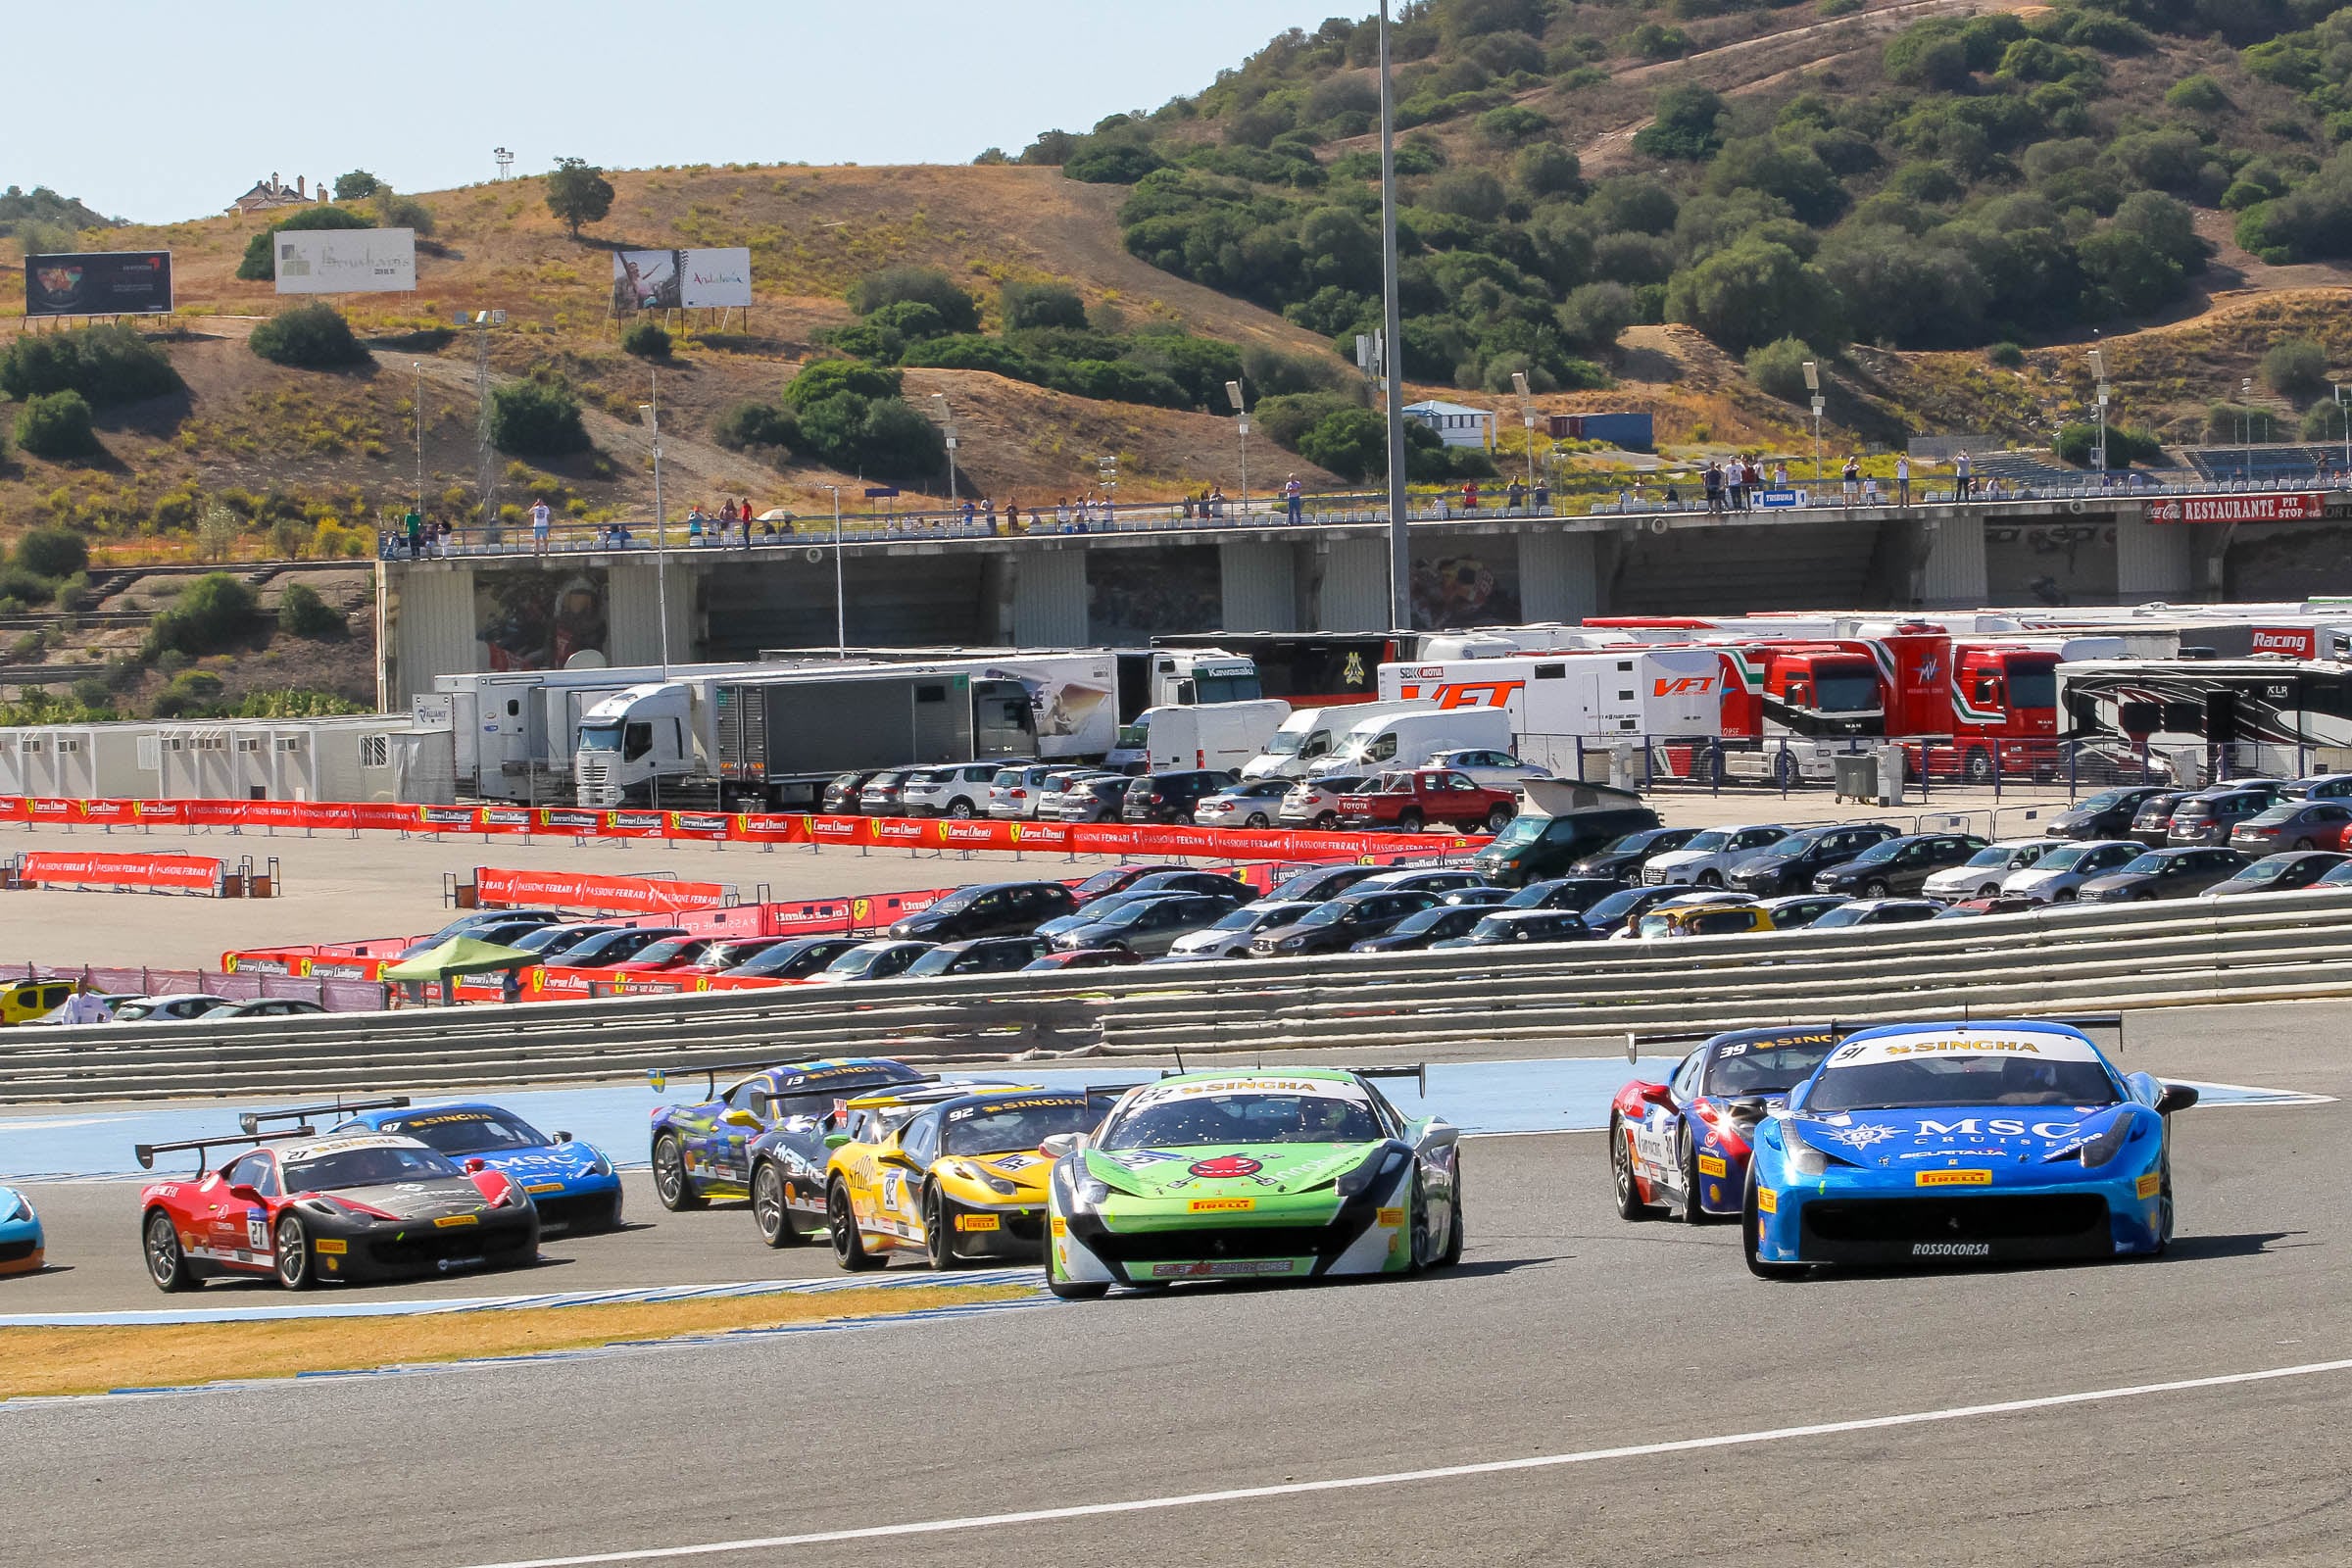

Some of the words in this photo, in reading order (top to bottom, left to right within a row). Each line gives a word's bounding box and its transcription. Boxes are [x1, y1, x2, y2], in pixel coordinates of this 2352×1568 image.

[2282, 497, 2299, 507] PIT
[2185, 499, 2275, 520] RESTAURANTE
[2278, 508, 2303, 518] STOP
[2253, 632, 2306, 652] Racing
[1207, 667, 1254, 677] Kawasaki
[1399, 667, 1417, 679] SBK
[1422, 666, 1444, 677] MOTUL
[1653, 677, 1715, 697] VFT
[747, 818, 765, 829] Corse
[765, 819, 787, 830] Clienti
[813, 820, 832, 830] Corse
[832, 820, 854, 831] Clienti
[880, 823, 900, 834] Corse
[900, 823, 922, 834] Clienti
[948, 825, 968, 836] Corse
[968, 825, 992, 837] Clienti
[1020, 827, 1041, 838] Corse
[1041, 827, 1065, 839] Clienti
[1176, 836, 1205, 845] FERRARI
[1218, 838, 1249, 848] PASSIONE
[1250, 840, 1281, 849] FERRARI
[1296, 840, 1327, 850] PASSIONE
[1328, 841, 1359, 851] FERRARI
[1373, 843, 1404, 852] PASSIONE
[122, 864, 146, 873] FERRARI
[183, 867, 206, 876] FERRARI
[517, 883, 544, 892] PASSIONE
[545, 884, 572, 893] FERRARI
[586, 886, 614, 896] PASSIONE
[615, 889, 646, 899] FERRARI
[690, 894, 720, 904] FERRARI
[1719, 1043, 1748, 1059] 39
[1911, 1040, 2040, 1053] SINGHA
[1836, 1046, 1867, 1060] 91
[786, 1076, 805, 1086] 13
[1205, 1081, 1317, 1092] SINGHA
[1001, 1099, 1086, 1109] SINGHA
[949, 1106, 974, 1122] 92
[1915, 1118, 2081, 1139] MSC
[1914, 1135, 2082, 1148] CRUISES
[287, 1151, 308, 1160] 27
[1700, 1159, 1723, 1174] PIRELLI
[1922, 1172, 1985, 1184] PIRELLI
[1193, 1200, 1250, 1210] PIRELLI
[966, 1217, 996, 1228] PIRELLI
[251, 1221, 264, 1247] 27
[1912, 1243, 1989, 1255] ROSSOCORSA
